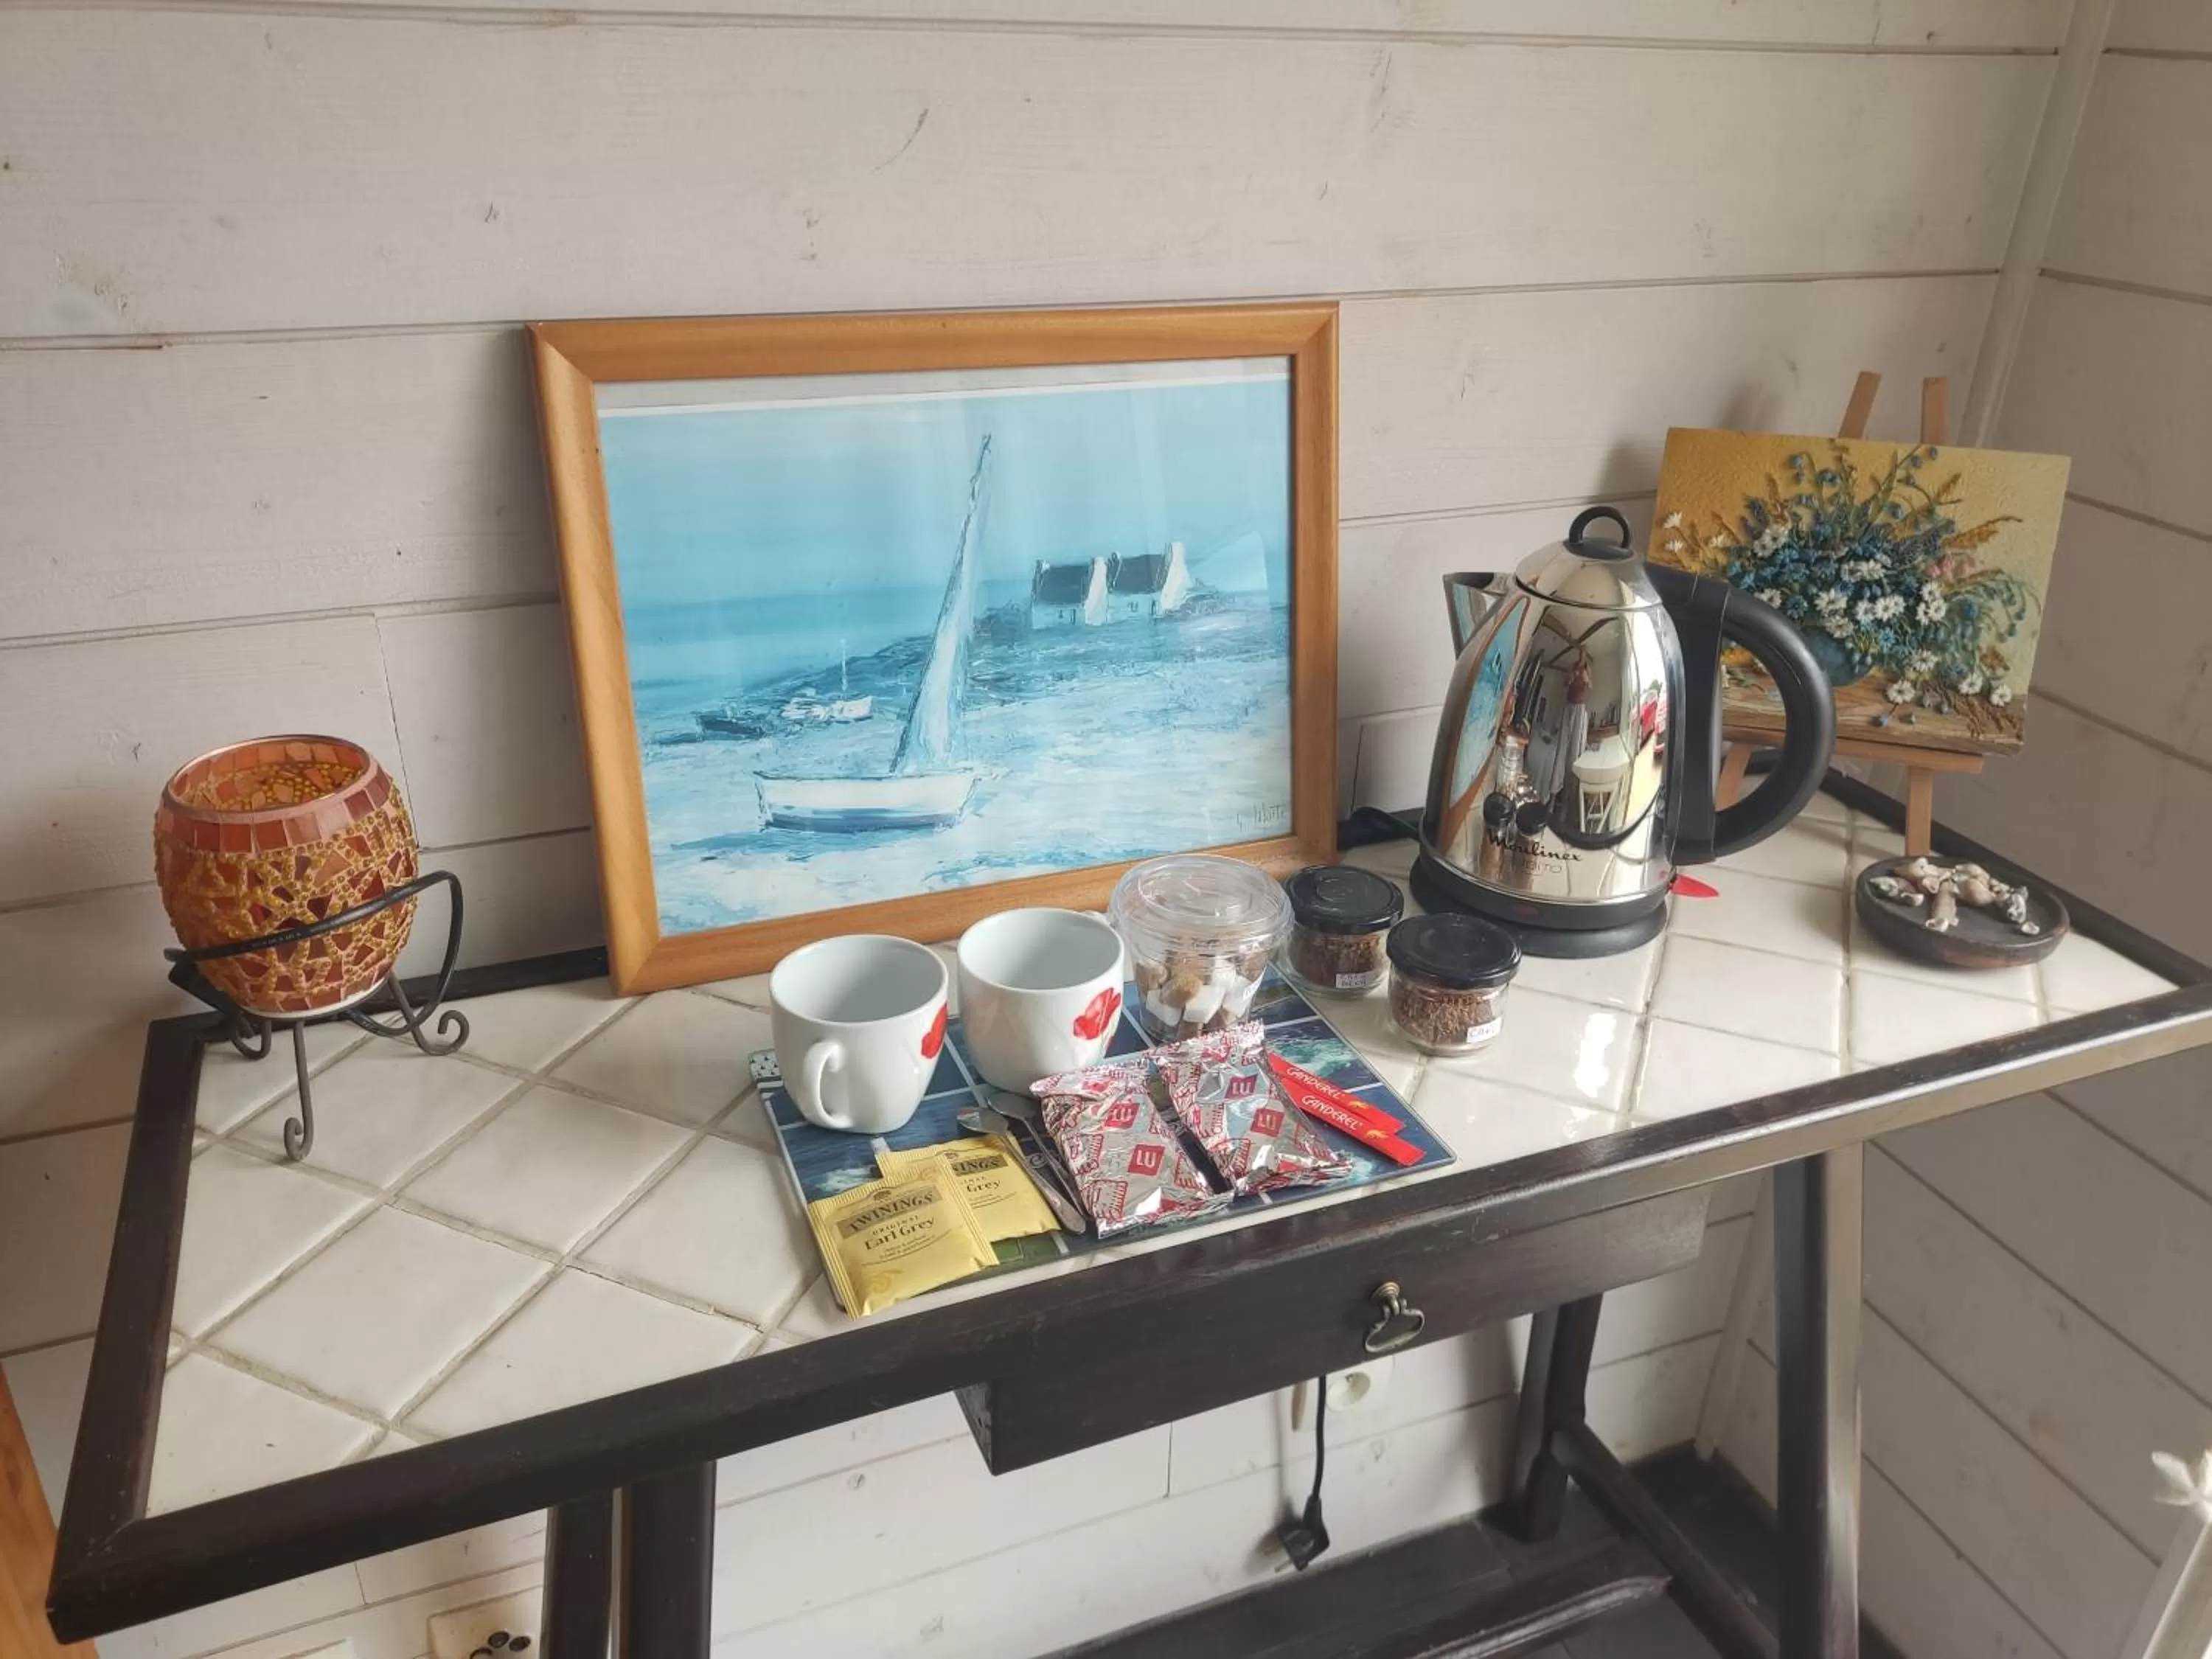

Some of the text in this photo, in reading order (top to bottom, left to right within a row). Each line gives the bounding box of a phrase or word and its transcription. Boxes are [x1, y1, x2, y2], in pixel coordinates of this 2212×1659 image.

[1487, 827, 1584, 861] Moulinex
[1232, 1082, 1251, 1096] LU
[1286, 1067, 1342, 1099] CANDEREL
[1257, 1114, 1276, 1130] LU
[1301, 1095, 1359, 1130] CANDEREL
[1136, 1150, 1157, 1167] LU
[967, 1180, 1001, 1192] Grey
[849, 1190, 934, 1232] TWININGS
[863, 1230, 897, 1251] Earl
[899, 1217, 935, 1237] Grey
